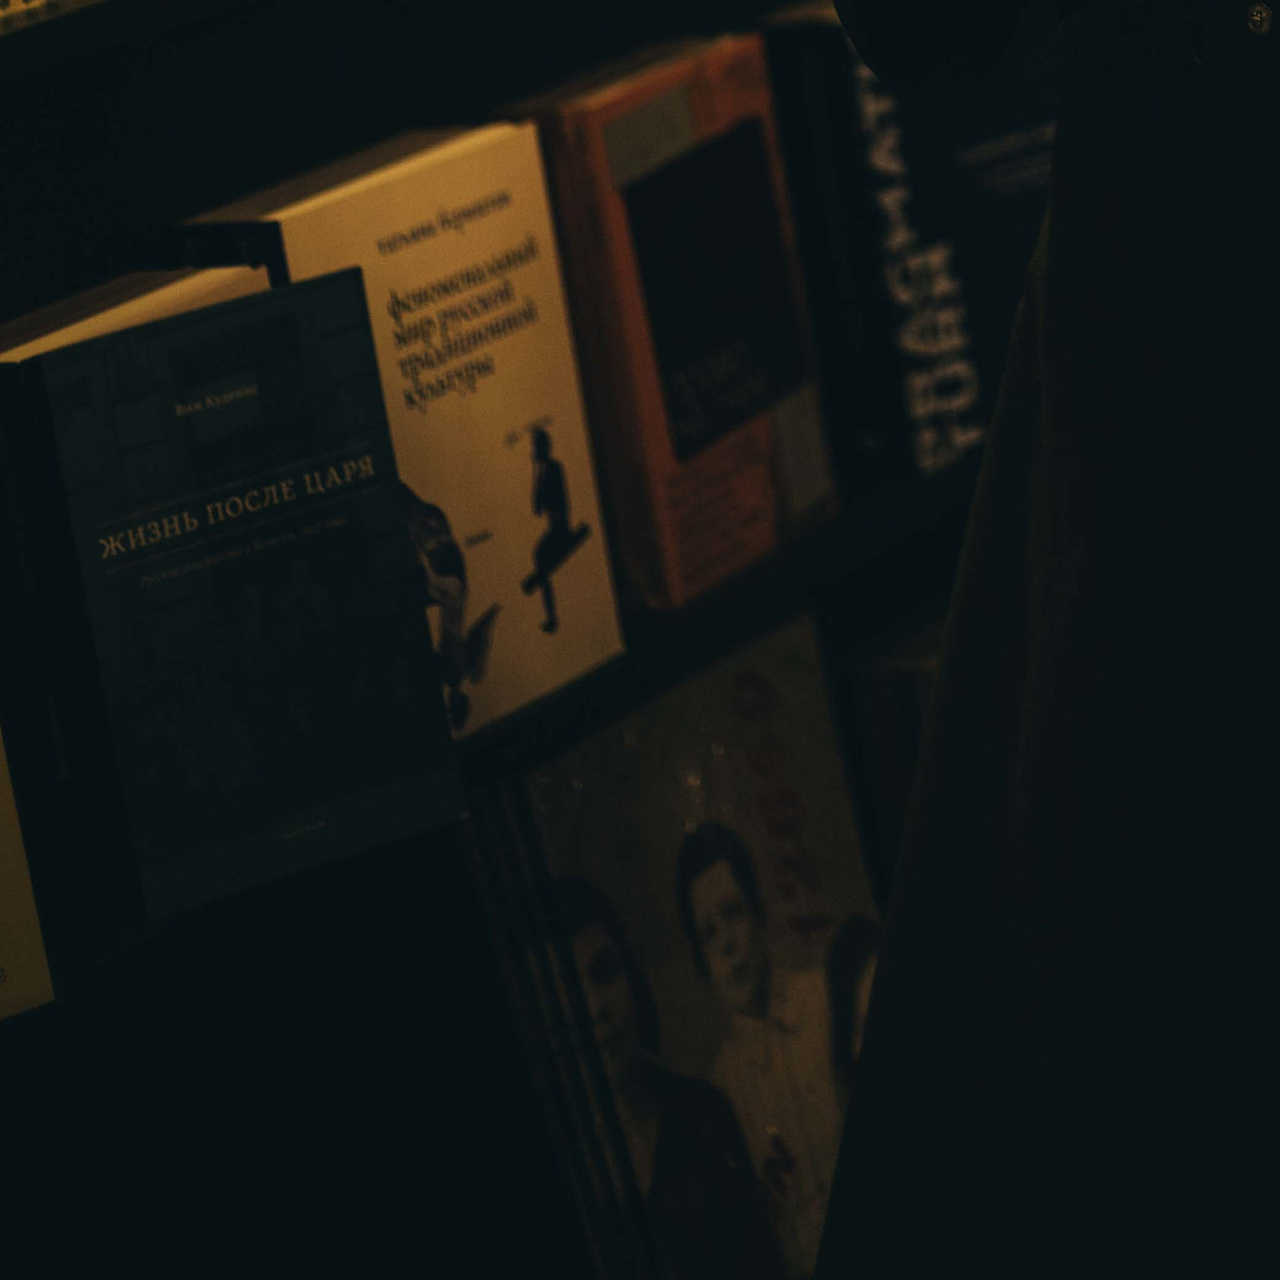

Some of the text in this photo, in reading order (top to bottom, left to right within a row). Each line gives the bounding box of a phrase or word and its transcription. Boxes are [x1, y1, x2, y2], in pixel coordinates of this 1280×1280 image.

[97, 510, 200, 560] ЖИЗНЬ
[205, 477, 298, 525] ПОСЛЕ
[302, 454, 376, 496] ЦАРЯ
